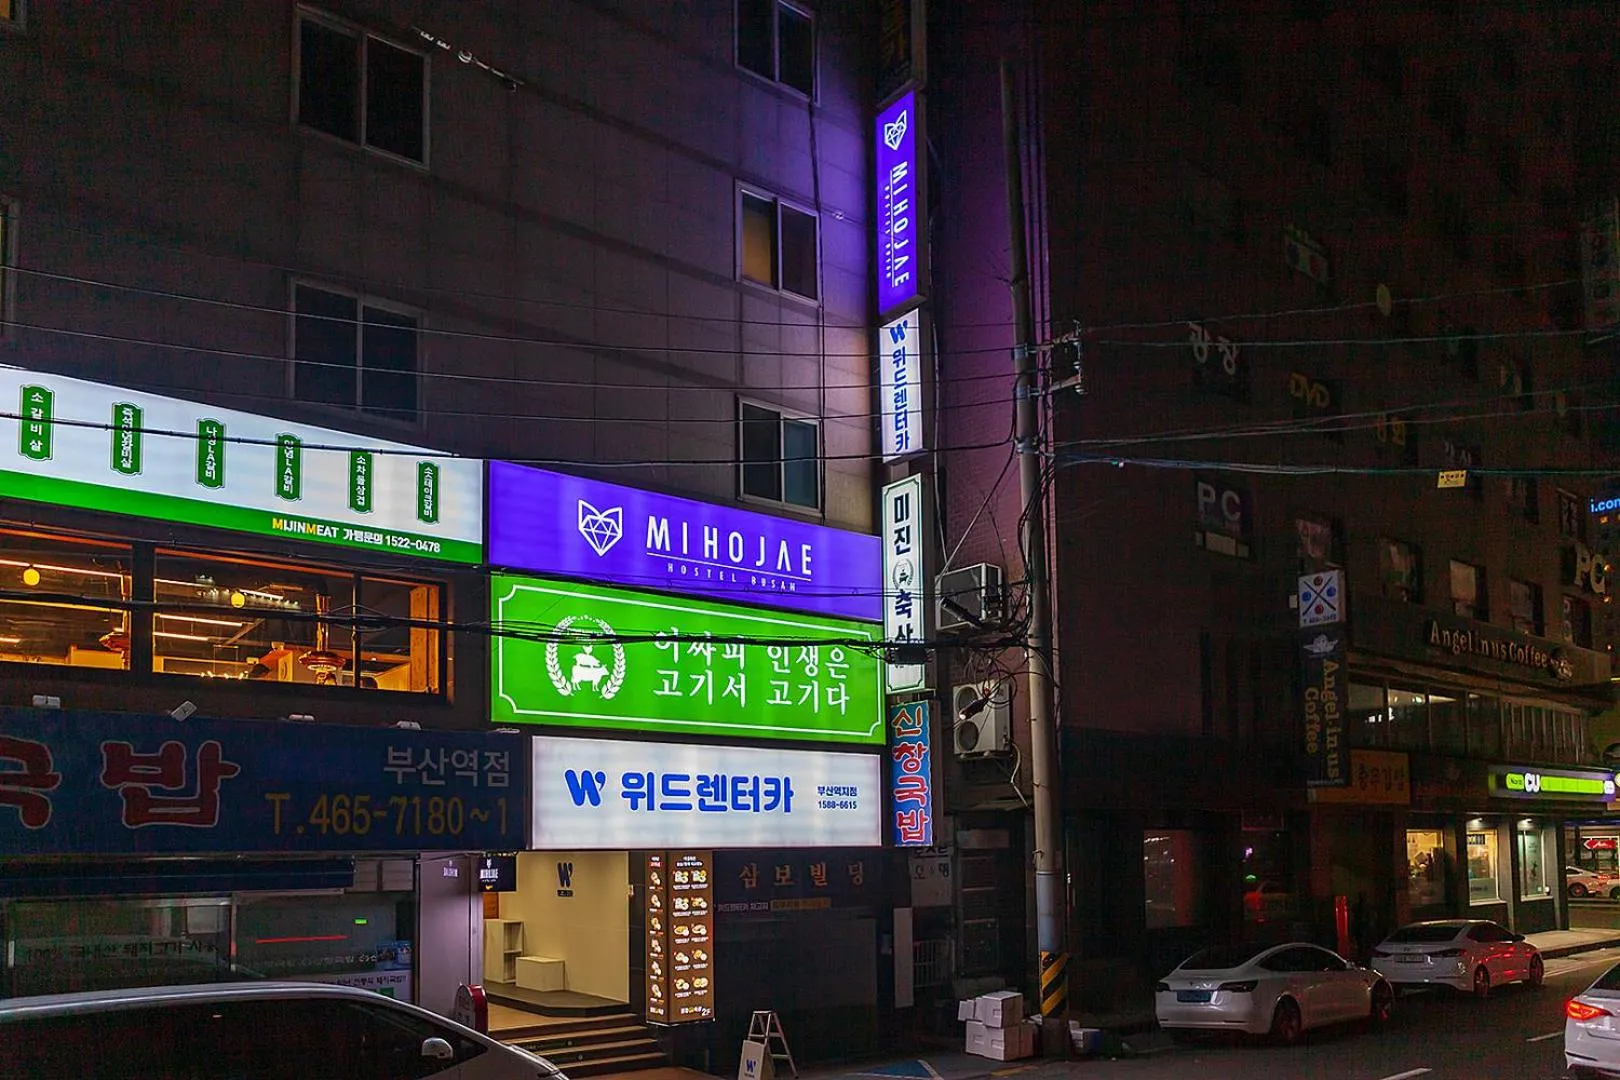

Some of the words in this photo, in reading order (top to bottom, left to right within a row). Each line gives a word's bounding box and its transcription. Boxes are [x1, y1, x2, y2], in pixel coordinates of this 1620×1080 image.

[893, 161, 910, 287] MIHOJAE
[893, 346, 909, 452] 위드렌터카
[29, 392, 44, 452] 소갈비살
[1197, 481, 1242, 523] PC
[272, 518, 339, 538] MIJINMEAT
[385, 535, 441, 552] 1522-0478
[646, 515, 812, 575] MIHOJAE
[894, 493, 911, 555] 미진
[667, 562, 737, 583] HOSTEL
[751, 575, 796, 592] BUSAN
[767, 642, 850, 679] 인생은
[653, 669, 746, 708] 고기서
[766, 680, 850, 715] 고기다
[383, 746, 511, 788] 부산역점
[891, 705, 929, 842] 신창국밥
[1525, 772, 1540, 792] CU
[621, 771, 795, 813] 위드렌터카
[817, 785, 858, 797] 부산역지점
[818, 799, 858, 810] 1588-6615
